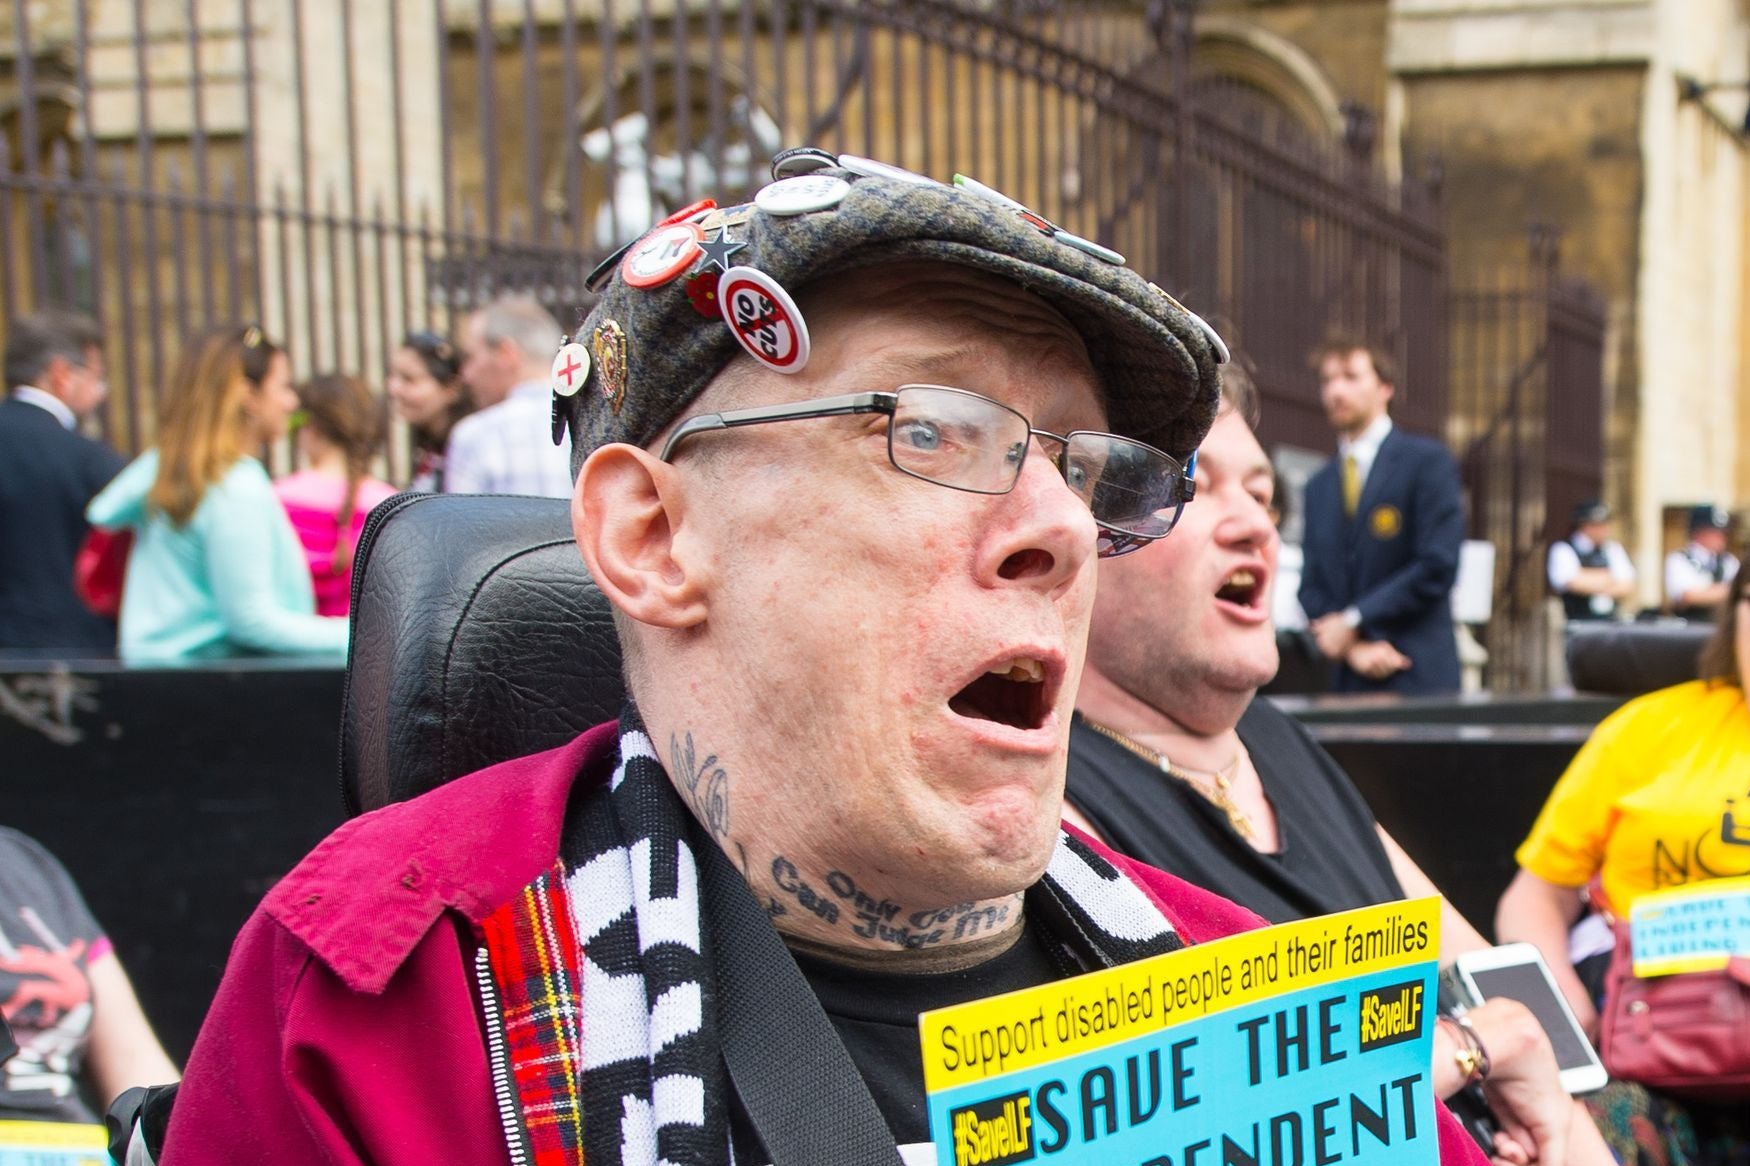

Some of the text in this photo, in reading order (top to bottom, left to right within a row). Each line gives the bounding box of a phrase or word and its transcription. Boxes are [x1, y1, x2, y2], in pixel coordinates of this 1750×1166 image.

[737, 293, 757, 339] NO
[759, 294, 779, 359] CUTS
[941, 915, 1430, 1076] Support disabled people and their families
[1036, 995, 1348, 1154] SAVE THE
